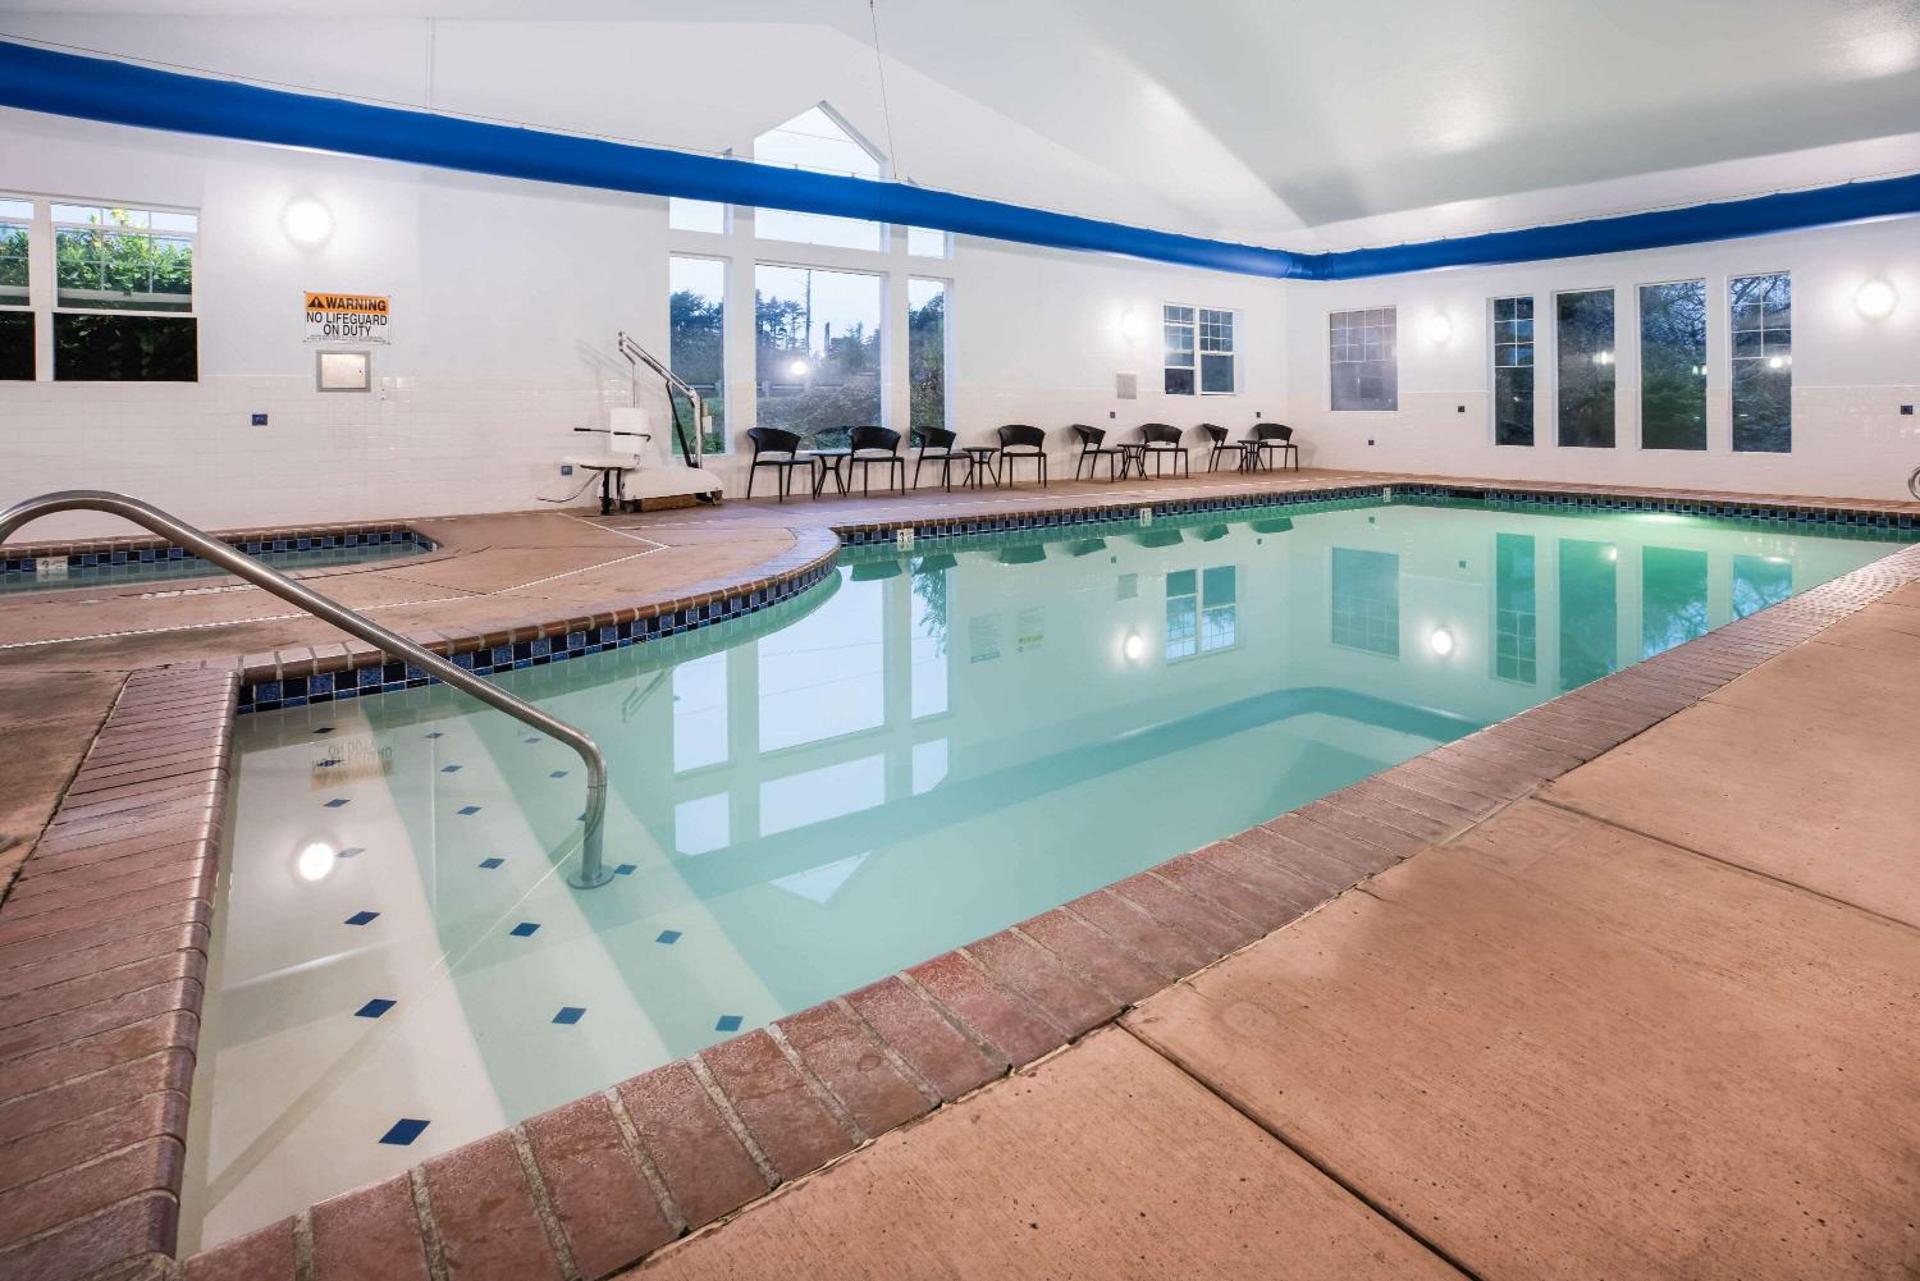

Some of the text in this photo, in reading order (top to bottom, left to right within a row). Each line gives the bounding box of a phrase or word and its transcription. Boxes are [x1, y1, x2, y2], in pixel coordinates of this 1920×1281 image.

[326, 297, 386, 311] WARNING
[307, 312, 387, 325] NO LIFEGUARD
[324, 324, 371, 336] ON DUTY
